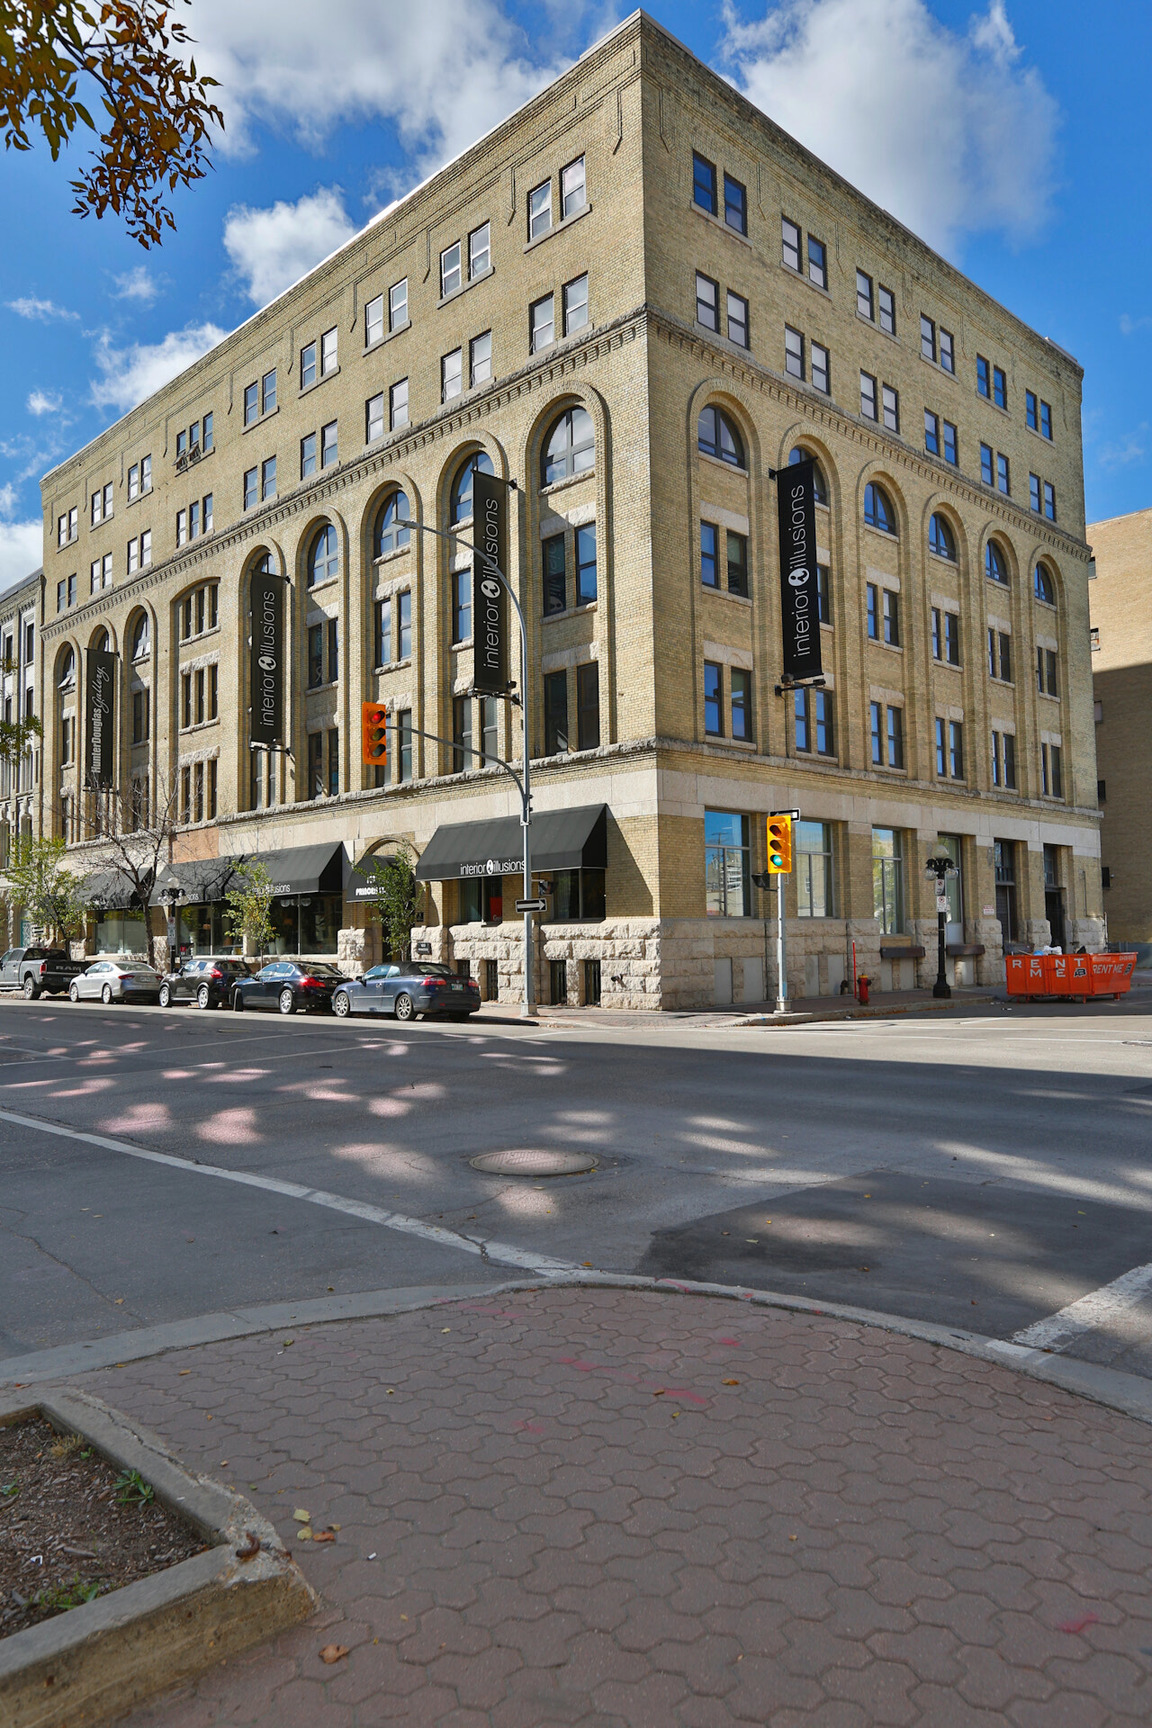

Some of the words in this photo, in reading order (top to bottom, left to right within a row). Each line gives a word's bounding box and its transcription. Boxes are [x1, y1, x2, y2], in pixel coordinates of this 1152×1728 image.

[482, 498, 499, 581] illusions
[788, 484, 807, 569] illusions
[260, 591, 275, 656] illusions
[483, 600, 499, 669] interior
[791, 589, 811, 657] interior
[260, 673, 275, 726] interior
[460, 862, 486, 875] interior
[493, 858, 525, 873] illusions
[55, 965, 82, 973] RAM
[1012, 958, 1084, 969] RENT
[1092, 964, 1113, 975] RENT
[1112, 963, 1124, 974] ME
